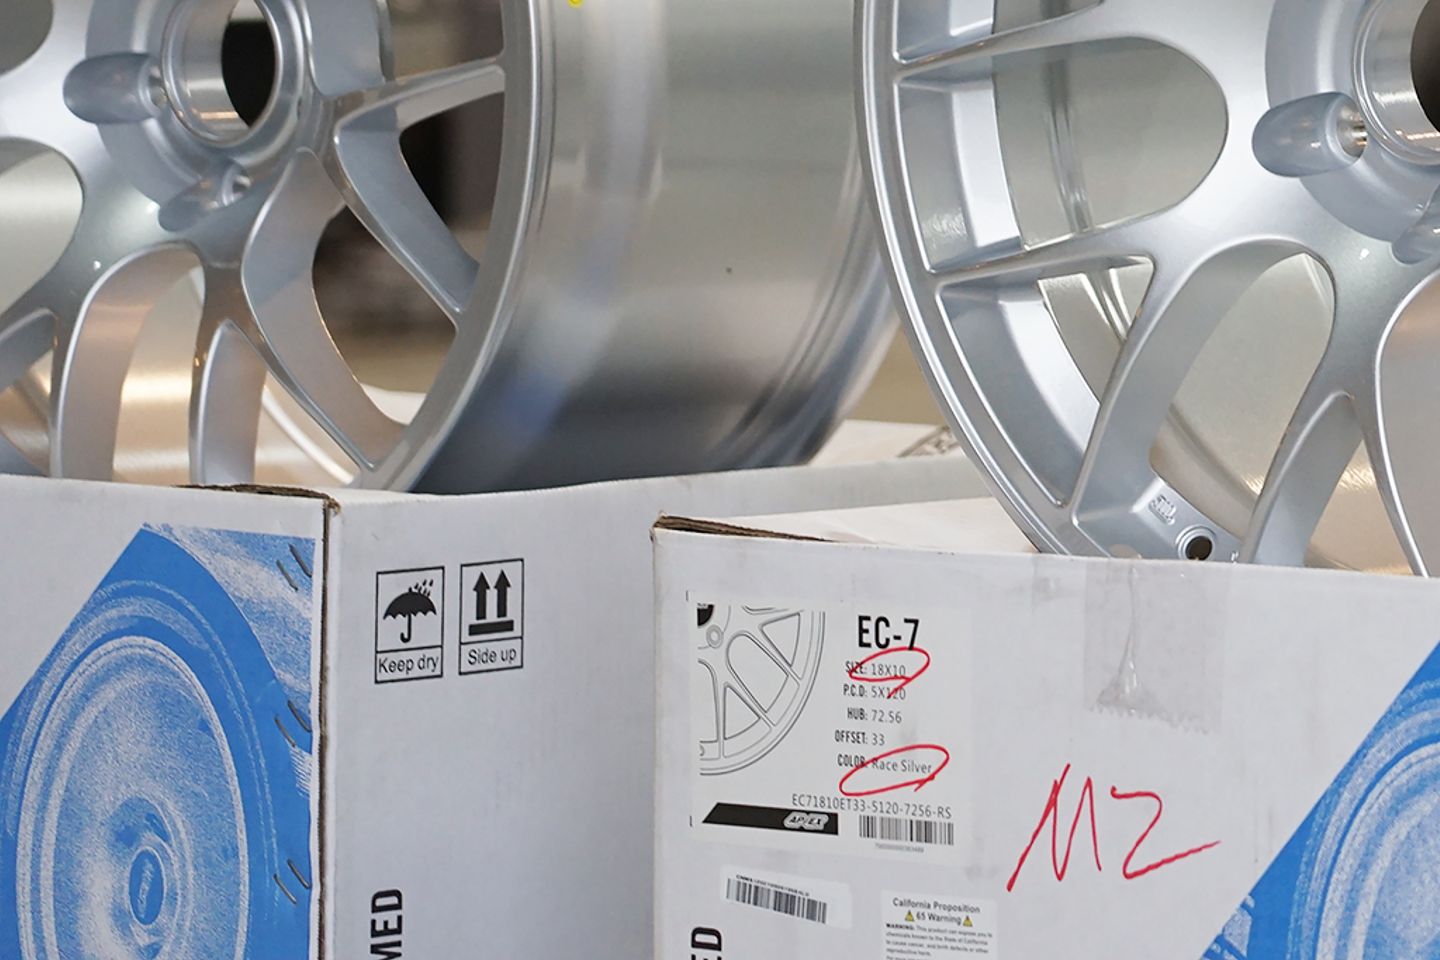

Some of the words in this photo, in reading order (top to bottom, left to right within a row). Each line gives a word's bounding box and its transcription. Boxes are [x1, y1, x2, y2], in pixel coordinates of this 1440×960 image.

[858, 615, 919, 651] EC-7
[378, 657, 414, 675] Keep
[417, 654, 439, 673] dry
[467, 649, 497, 666] Side
[501, 648, 517, 664] up
[871, 663, 906, 677] 18X10
[843, 683, 868, 698] P.C.D:
[871, 686, 906, 700] 5X120
[847, 707, 868, 721] HUB:
[872, 709, 902, 724] 72.56
[834, 729, 868, 744] OFFSET:
[872, 732, 885, 746] 33
[837, 753, 868, 769] COLOR:
[872, 757, 898, 772] Race
[901, 759, 932, 774] Silver
[792, 793, 952, 819] EC71810ET33-5120-7256-RS
[892, 897, 931, 910] California
[933, 901, 980, 914] Proposition
[370, 888, 403, 960] MED
[916, 911, 926, 921] 65
[928, 913, 962, 926] Warning
